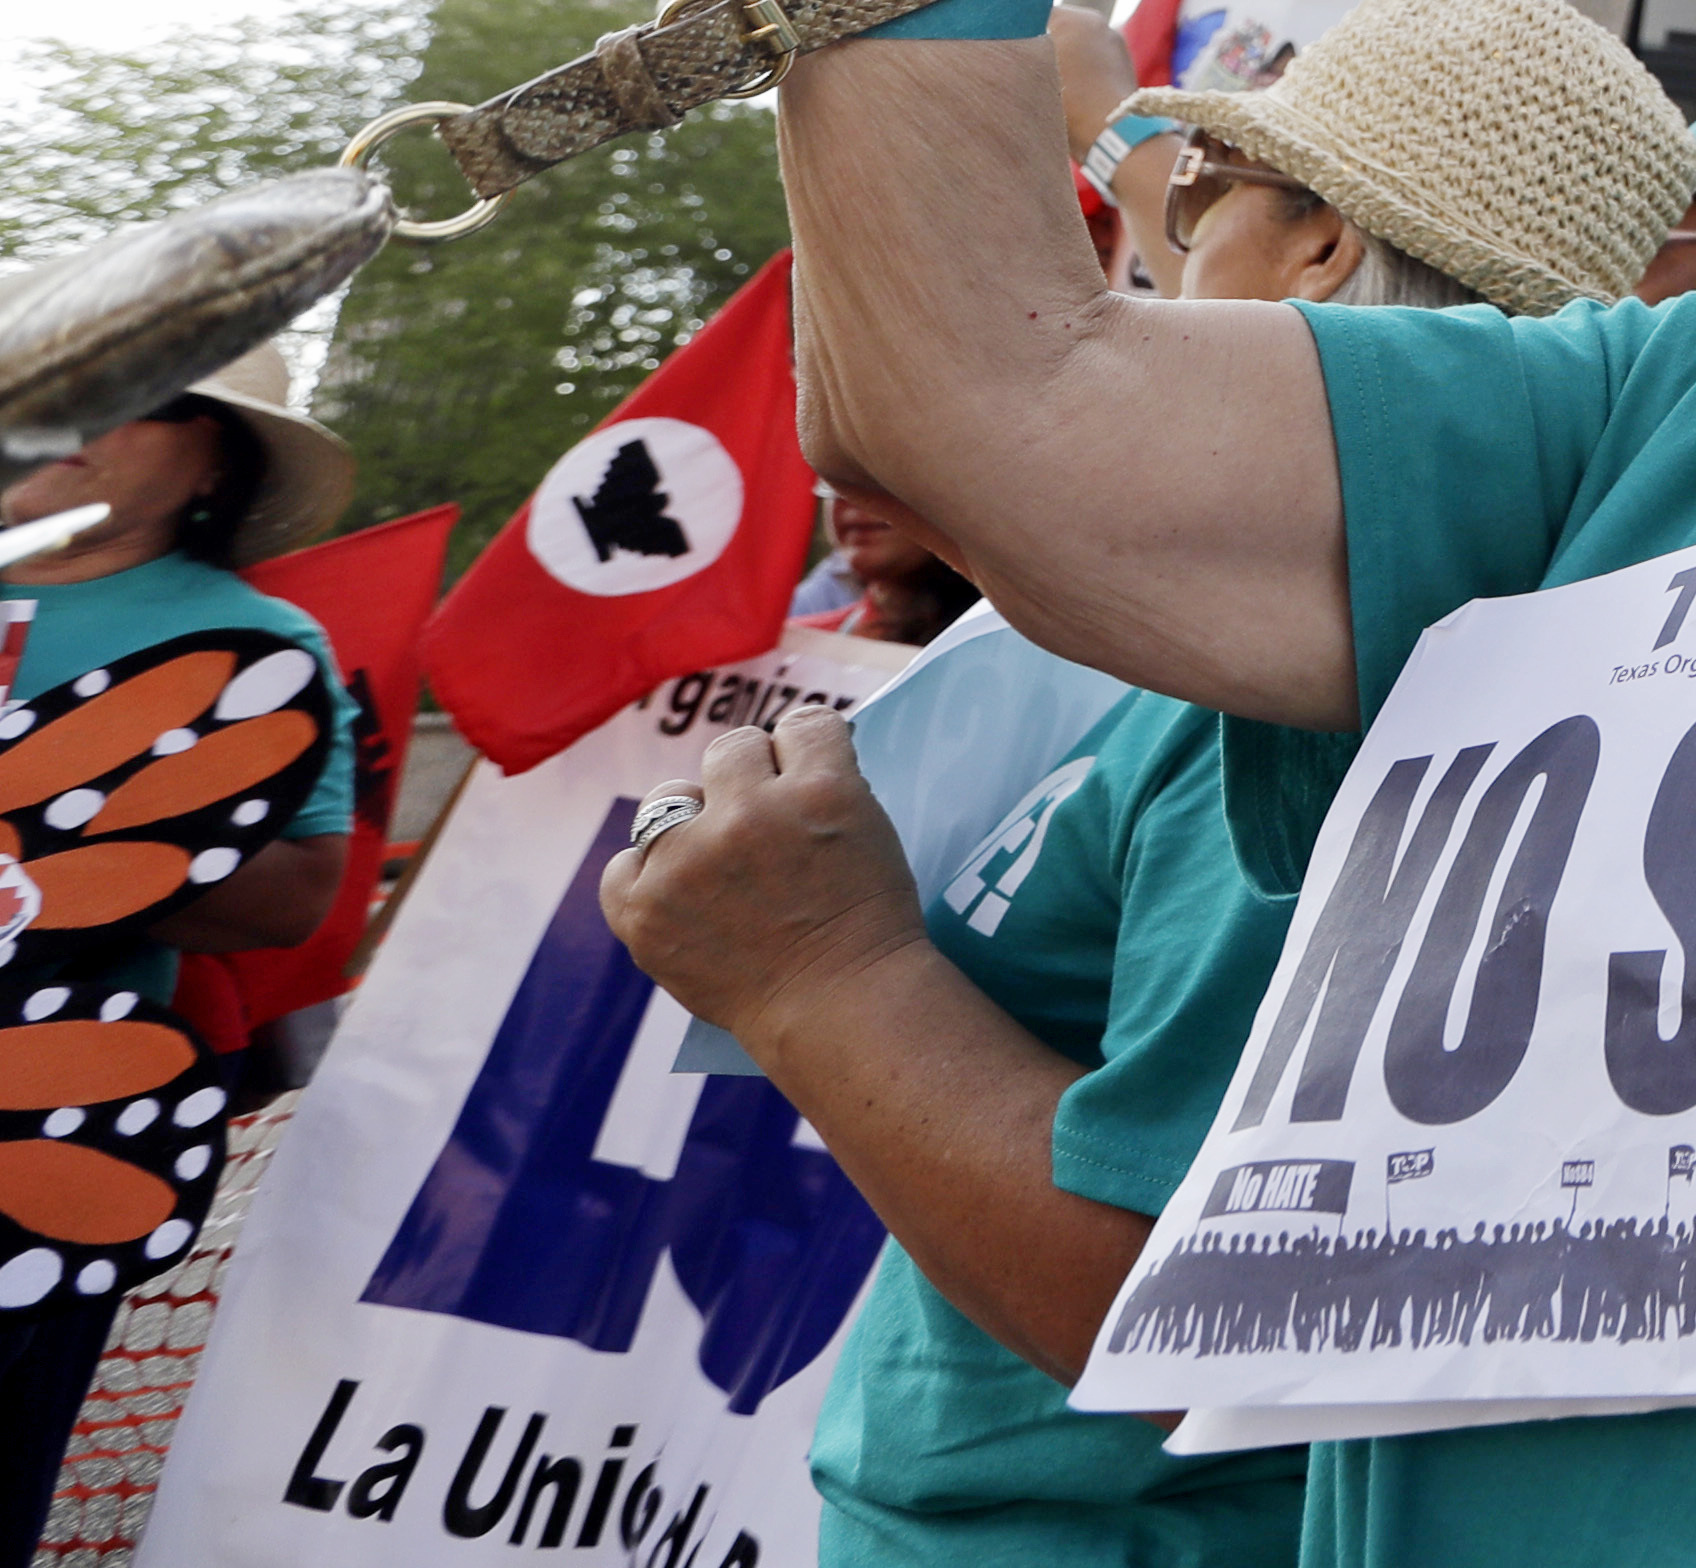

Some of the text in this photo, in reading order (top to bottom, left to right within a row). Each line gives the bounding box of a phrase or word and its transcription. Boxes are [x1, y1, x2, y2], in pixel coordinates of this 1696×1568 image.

[1609, 659, 1659, 686] Texas
[1228, 714, 1601, 1134] NO
[1258, 1163, 1323, 1210] HATE
[283, 1378, 427, 1523] La
